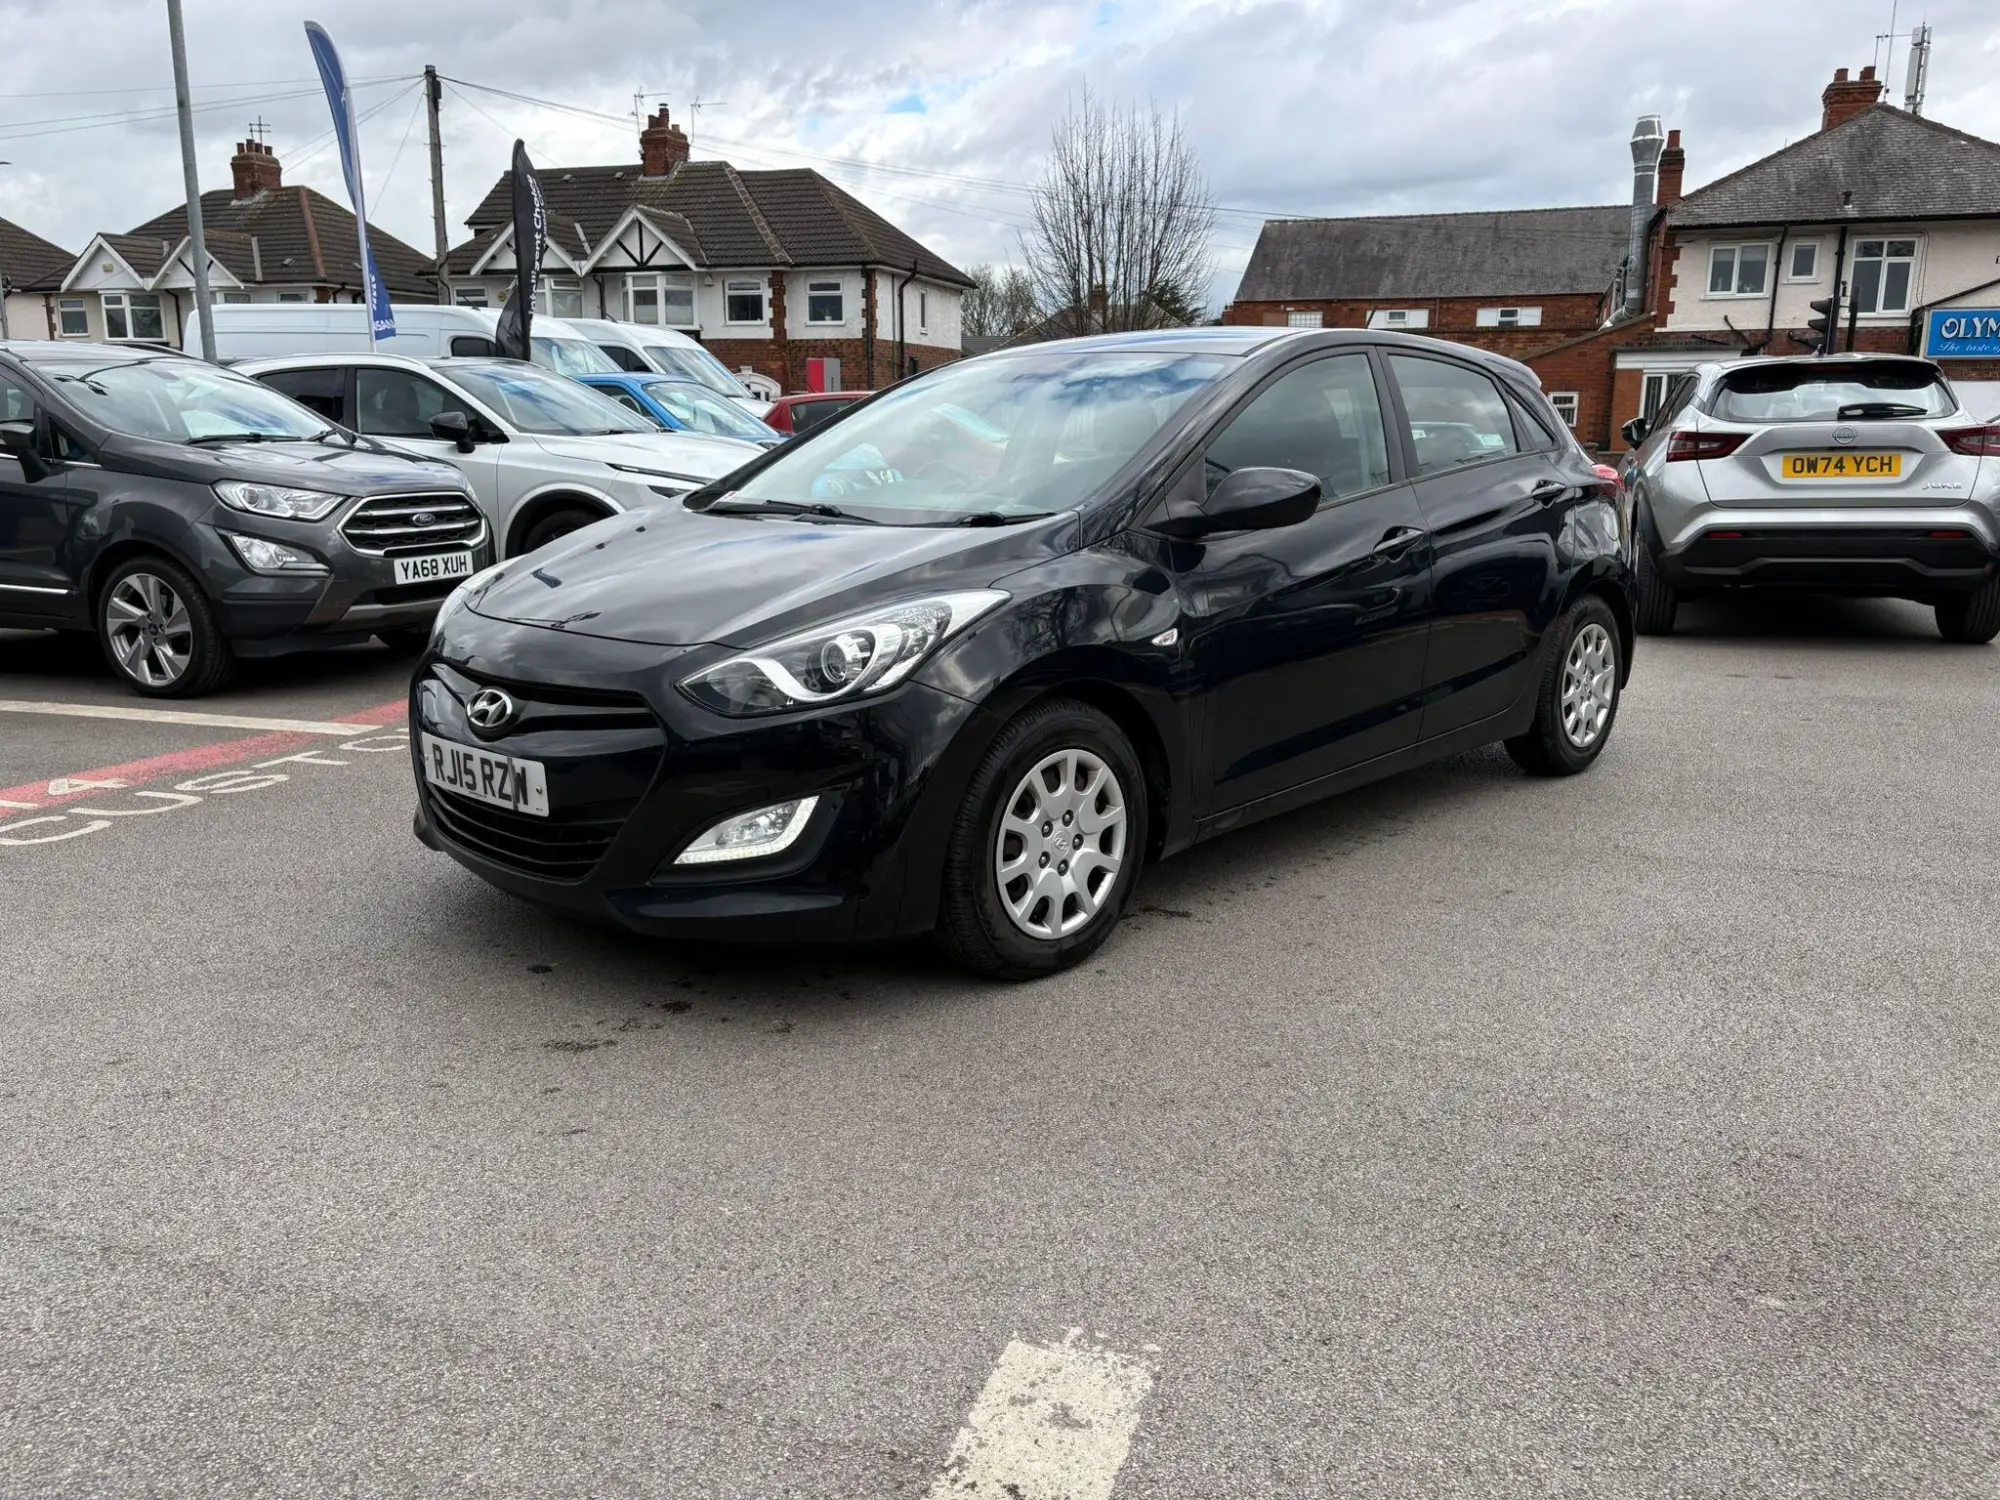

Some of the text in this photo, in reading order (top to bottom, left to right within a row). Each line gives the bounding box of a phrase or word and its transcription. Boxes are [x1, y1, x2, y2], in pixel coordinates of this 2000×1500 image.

[526, 173, 542, 315] Intelligent Choice
[1792, 455, 1893, 474] OW74 YCH
[400, 555, 468, 580] YA68 XUH
[432, 742, 477, 791] RJ15
